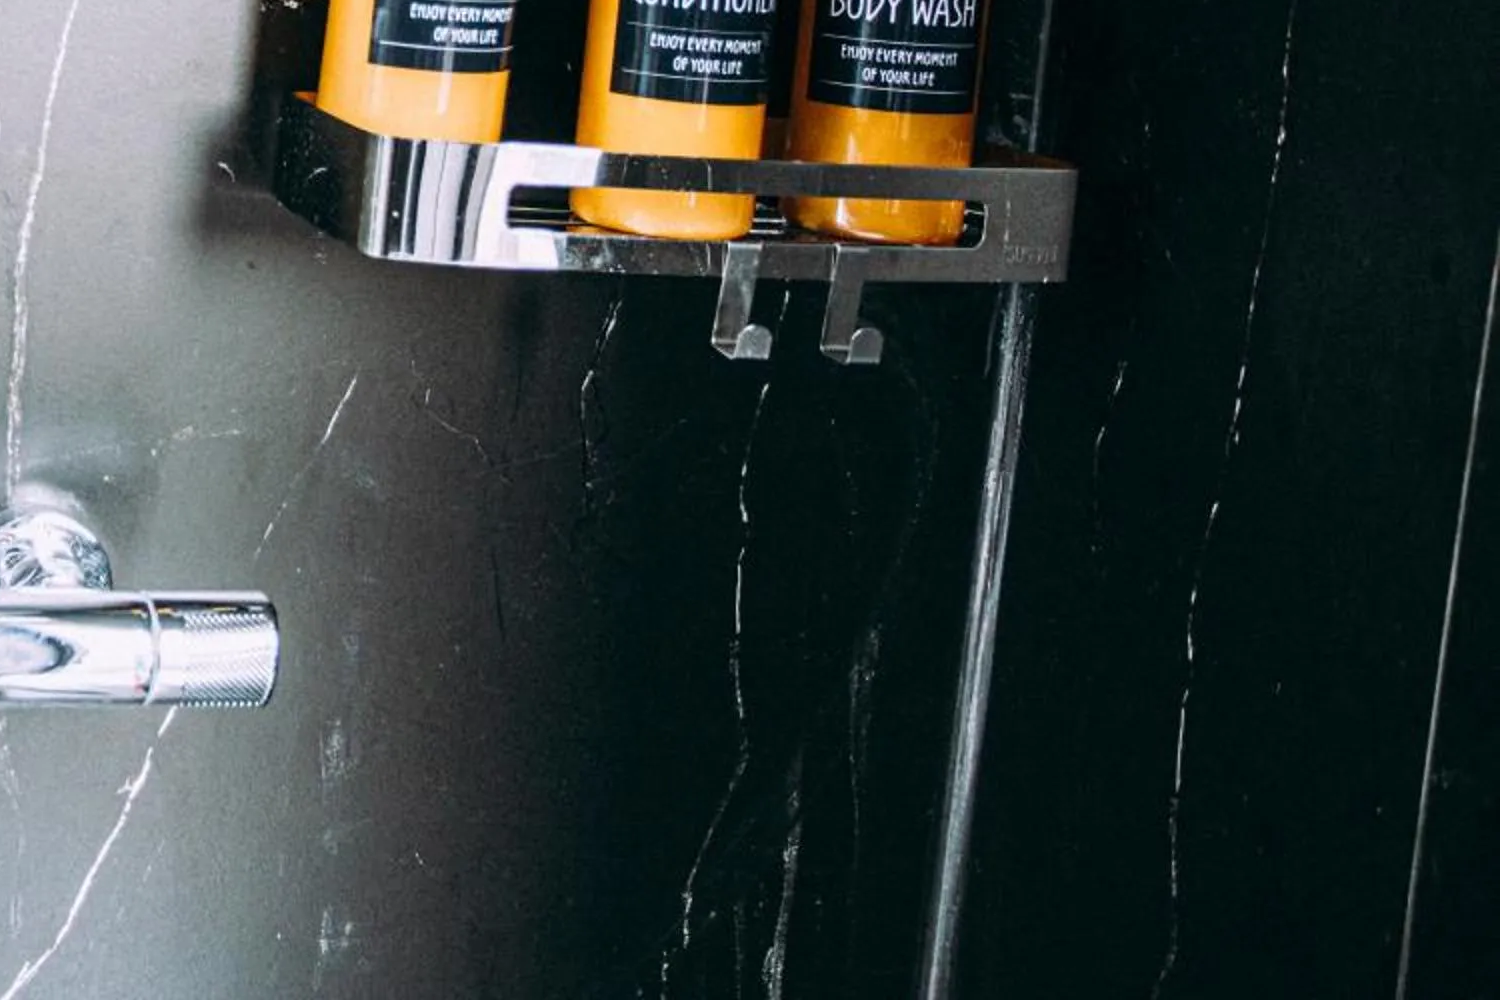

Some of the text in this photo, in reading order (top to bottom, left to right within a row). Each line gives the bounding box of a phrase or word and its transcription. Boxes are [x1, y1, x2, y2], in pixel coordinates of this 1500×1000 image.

[409, 2, 446, 21] ENJOY
[447, 6, 481, 23] EVERY
[433, 26, 499, 45] OF YOUR LIFE
[650, 31, 762, 54] ENJOY EVERY MOMENT
[673, 55, 743, 75] OF YOUR LIFE
[840, 43, 959, 67] ENJOY EVERY MOMENT
[862, 66, 936, 87] OF YOUR LIFE
